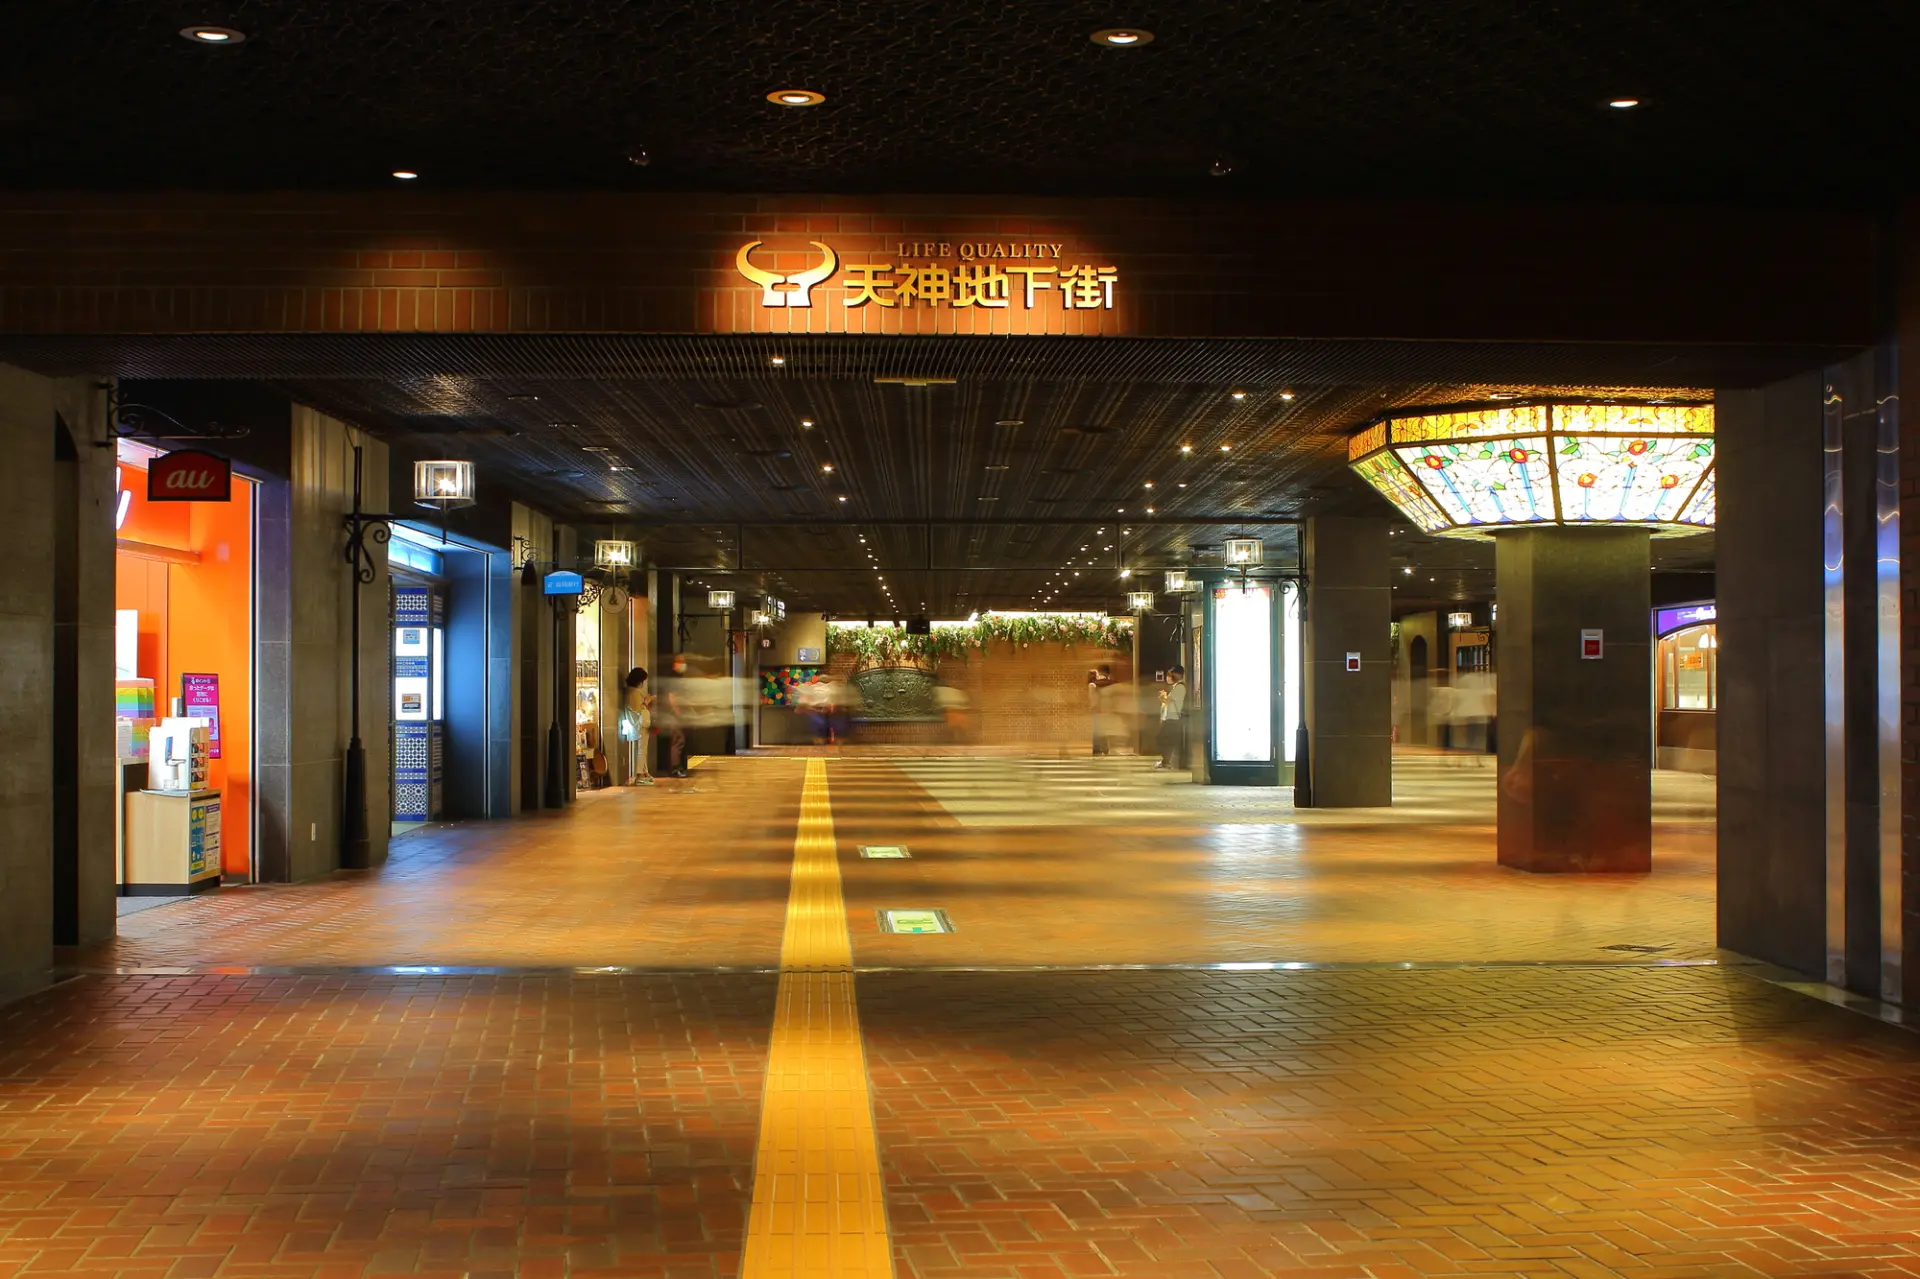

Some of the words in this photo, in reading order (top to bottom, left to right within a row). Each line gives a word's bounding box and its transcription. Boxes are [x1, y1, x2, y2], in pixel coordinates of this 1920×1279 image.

[898, 243, 951, 257] LIFE
[959, 243, 1063, 261] QUALITY
[842, 263, 1118, 309] 天神地下街
[166, 469, 216, 489] au
